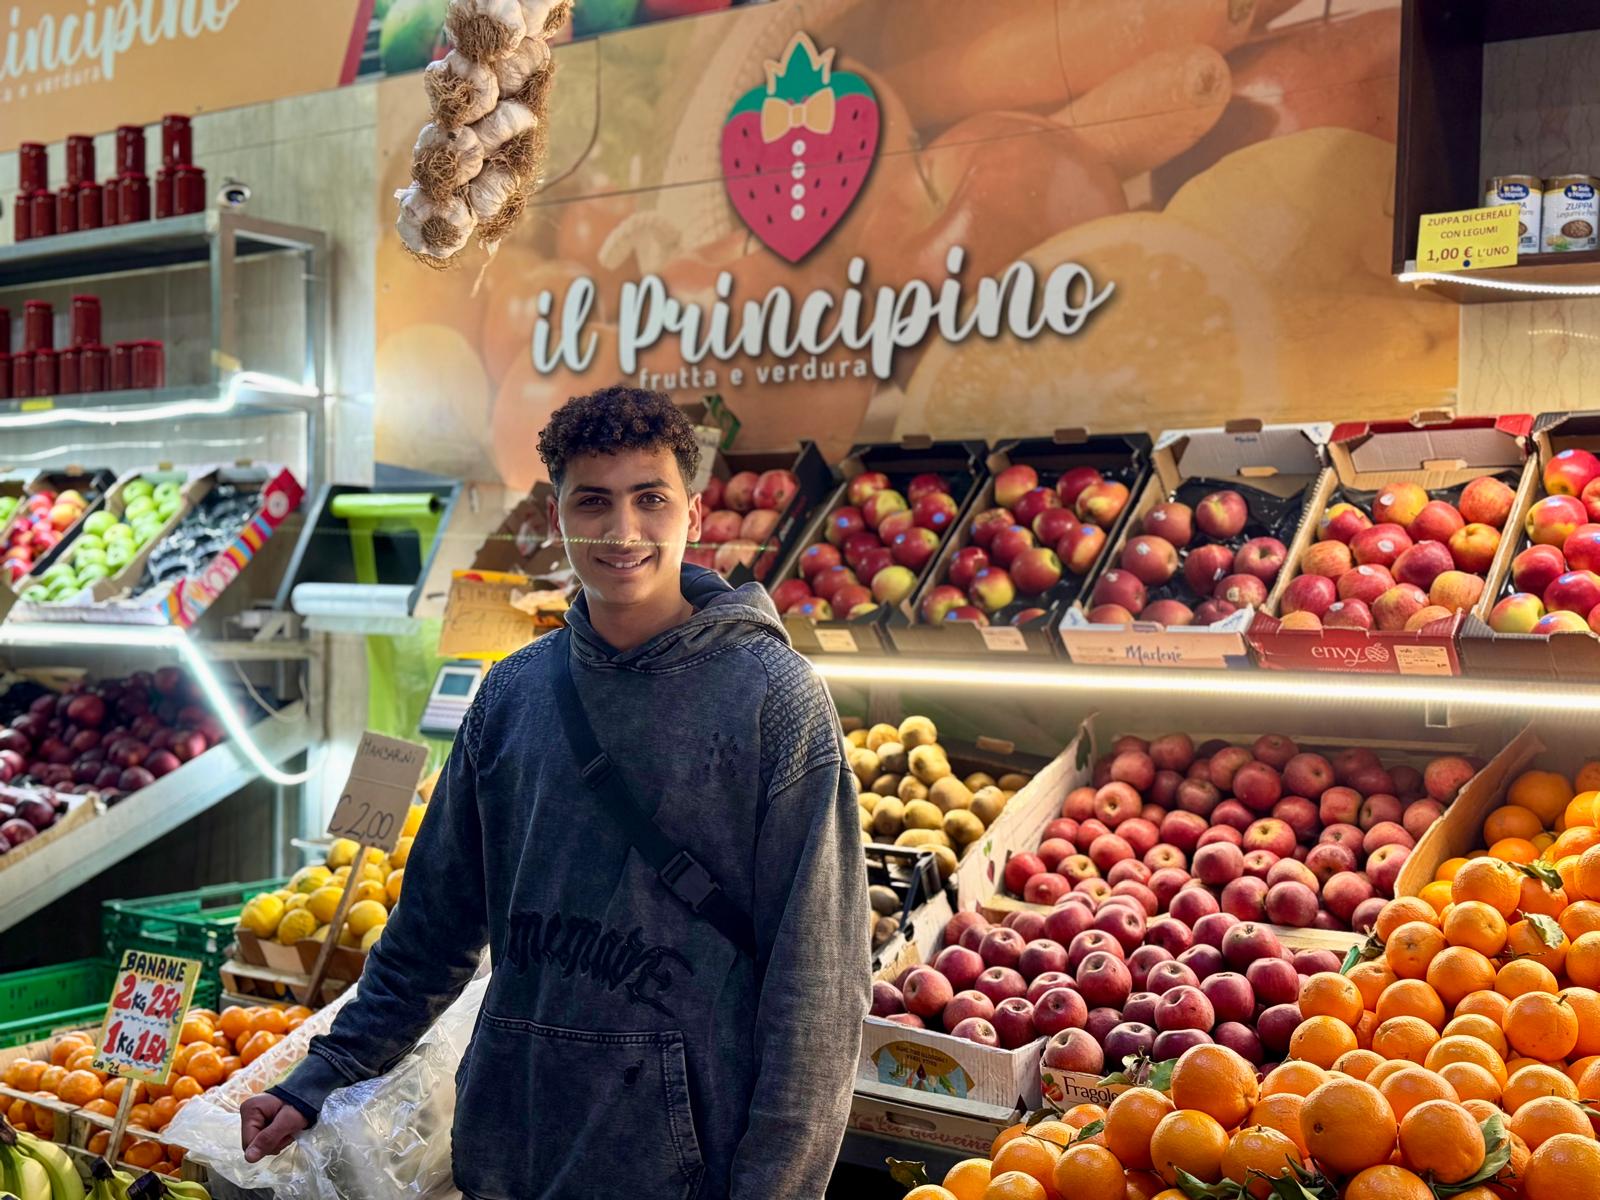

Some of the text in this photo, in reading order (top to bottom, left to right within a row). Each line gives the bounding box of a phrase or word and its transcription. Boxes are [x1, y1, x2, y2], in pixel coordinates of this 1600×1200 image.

[1427, 208, 1512, 227] ZUPPA DI CEREALI
[1440, 225, 1499, 239] CON LEGUMI
[1427, 247, 1460, 263] 1,00
[1464, 246, 1473, 258] €
[532, 244, 1115, 380] il Principino
[638, 356, 868, 390] frutta e verdura
[1311, 645, 1368, 667] envy
[120, 952, 187, 982] BANANE
[1062, 1075, 1119, 1104] Fragole
